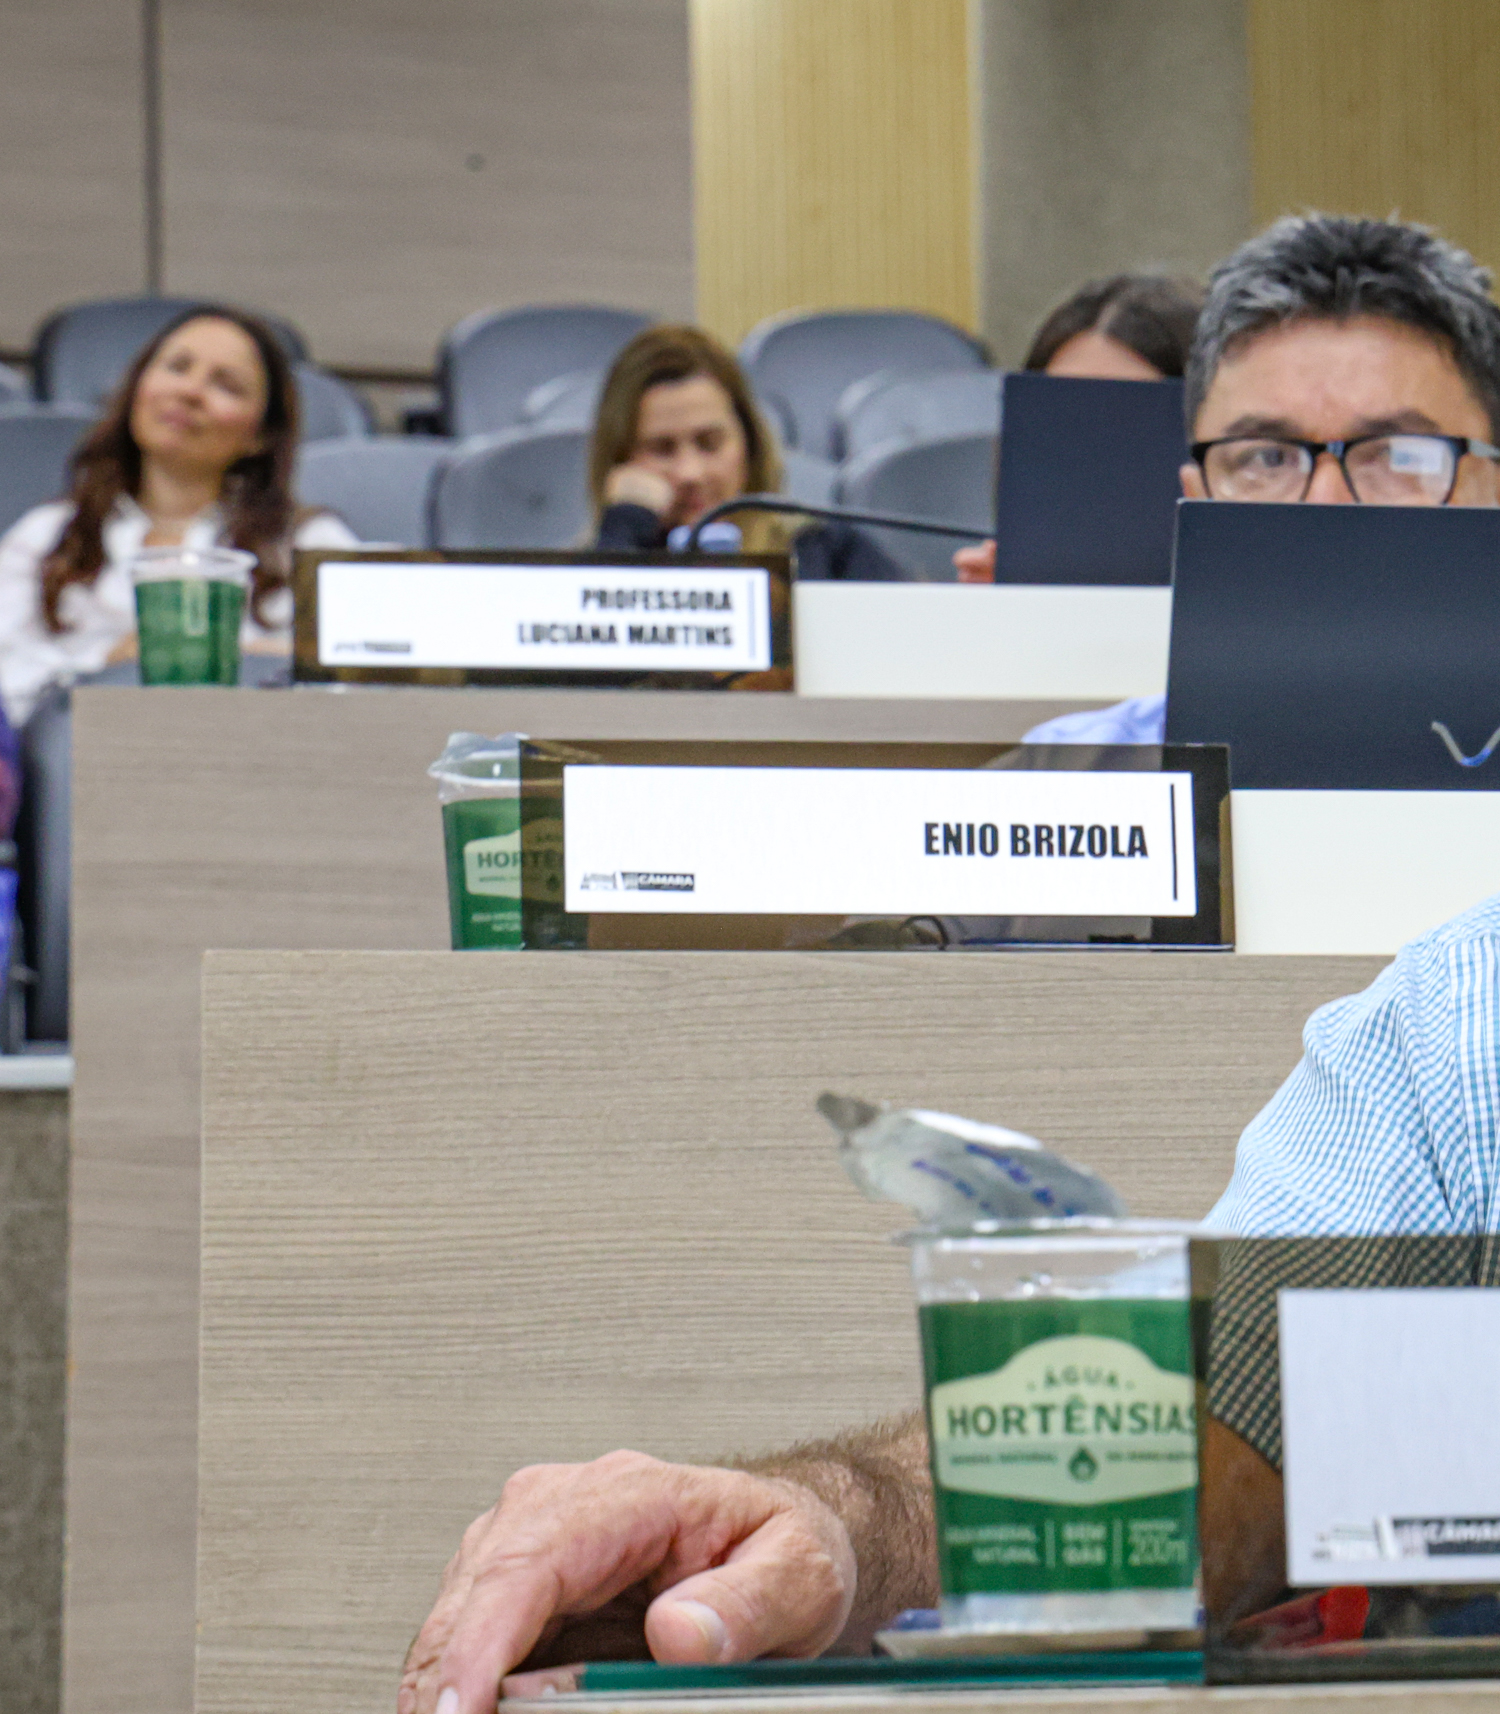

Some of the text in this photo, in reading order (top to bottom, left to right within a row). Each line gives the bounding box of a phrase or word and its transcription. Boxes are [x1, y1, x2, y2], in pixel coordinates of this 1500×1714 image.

[581, 588, 732, 610] PROFESSORA
[518, 623, 732, 646] LUCIANA MARTINS
[924, 822, 1149, 859] ENIO BRIZOLA
